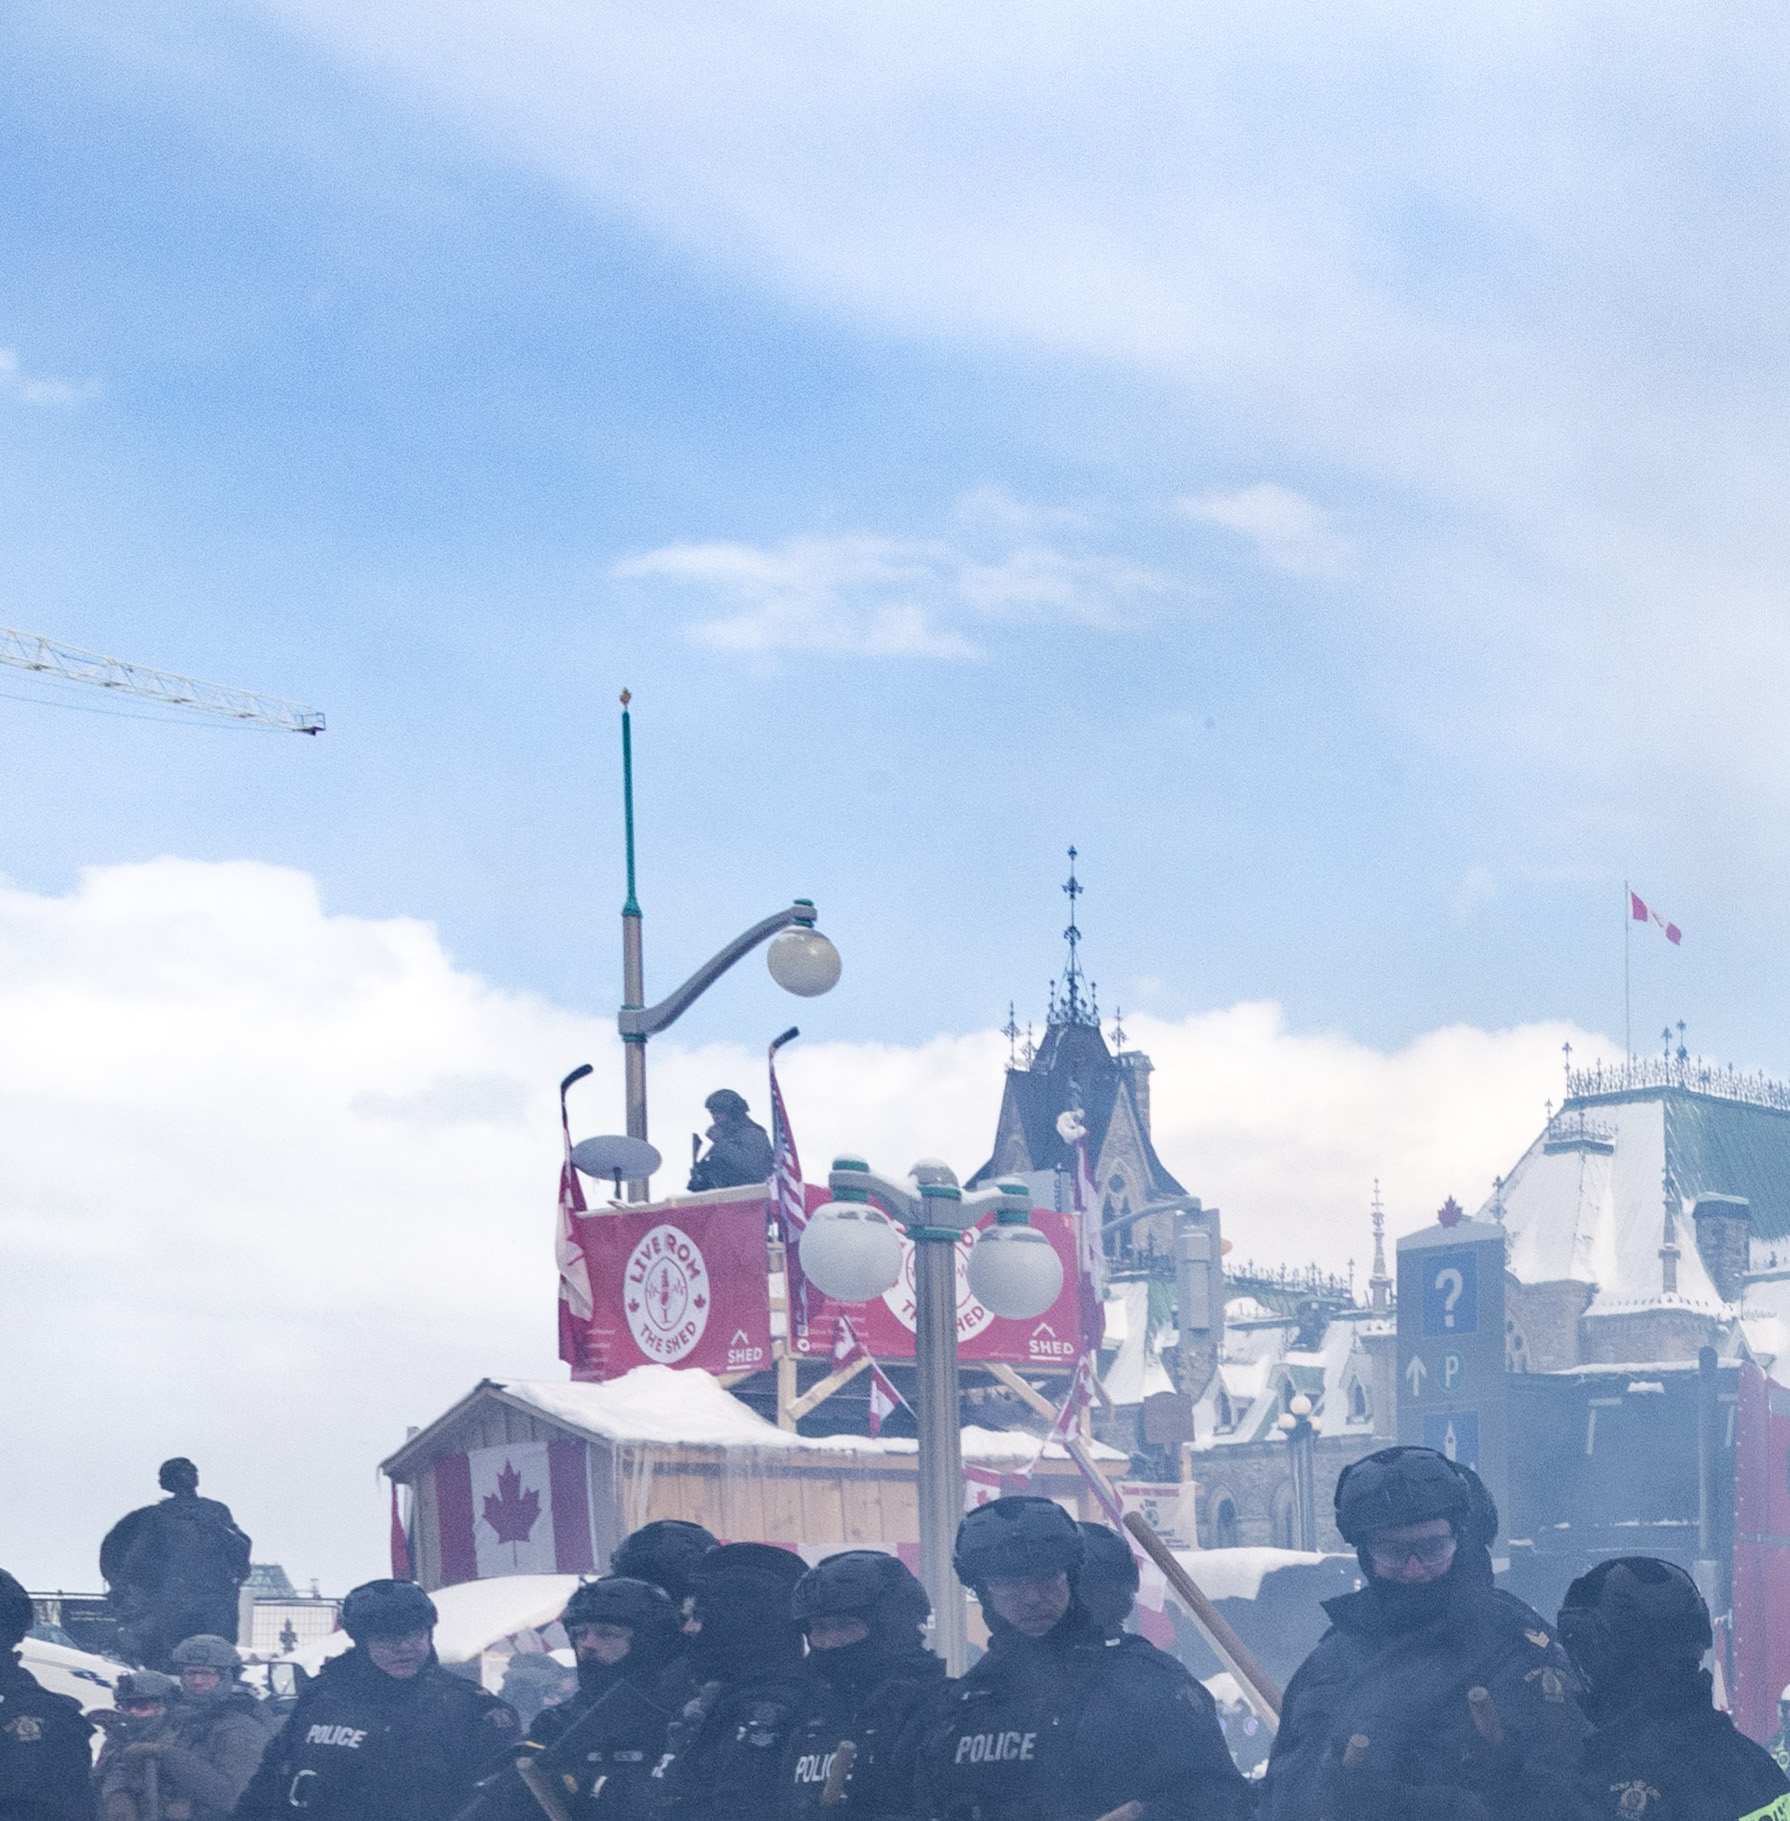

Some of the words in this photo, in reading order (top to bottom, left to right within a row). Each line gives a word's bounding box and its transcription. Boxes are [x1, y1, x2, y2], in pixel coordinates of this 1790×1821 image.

[629, 1236, 662, 1284] LIVE
[641, 1323, 663, 1353] THE
[665, 1321, 696, 1355] SHED
[1029, 1340, 1075, 1356] SHED
[727, 1348, 763, 1364] SHED
[1445, 1356, 1459, 1388] P
[306, 1724, 368, 1748] POLICE
[955, 1731, 1037, 1764] POLICE
[795, 1752, 857, 1783] POLIC
